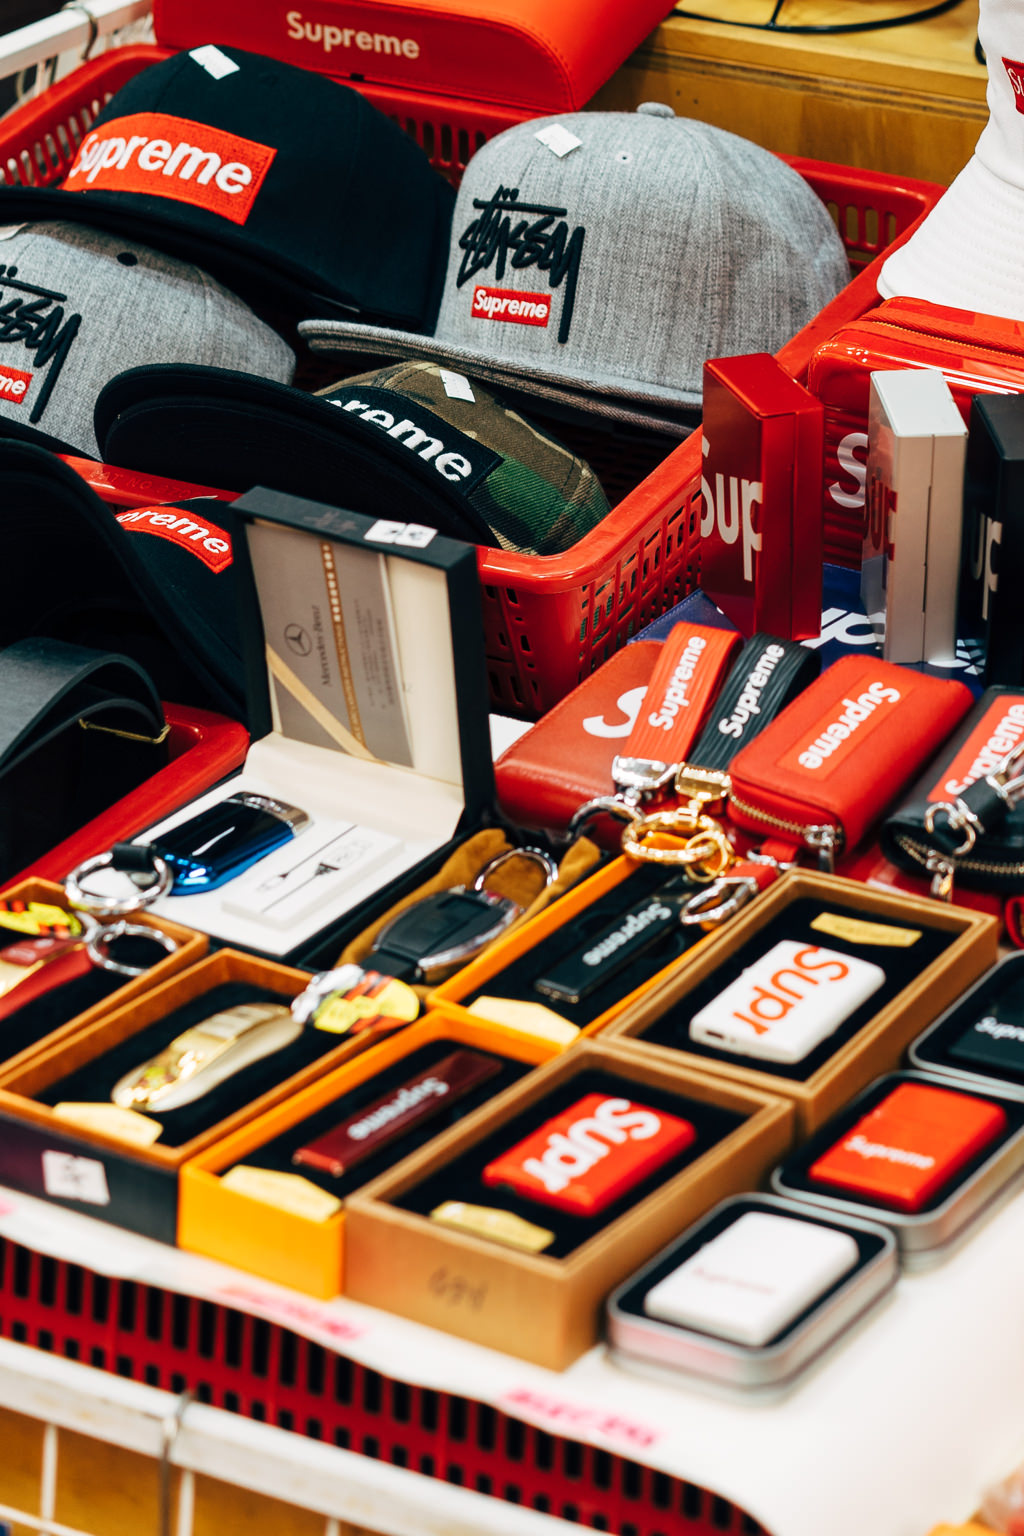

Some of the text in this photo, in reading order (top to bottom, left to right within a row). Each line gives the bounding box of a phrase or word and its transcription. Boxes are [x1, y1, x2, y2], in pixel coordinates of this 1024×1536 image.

[286, 10, 420, 59] Supreme
[69, 133, 253, 194] Supreme
[473, 288, 548, 319] Supreme
[648, 636, 707, 731] Supreme
[718, 644, 786, 738] Supreme
[798, 682, 901, 770] Supreme
[582, 903, 672, 966] Supreme
[732, 945, 849, 1035] Supr
[347, 1077, 450, 1140] Supreme
[522, 1098, 662, 1195] Supr
[844, 1134, 936, 1170] Supreme
